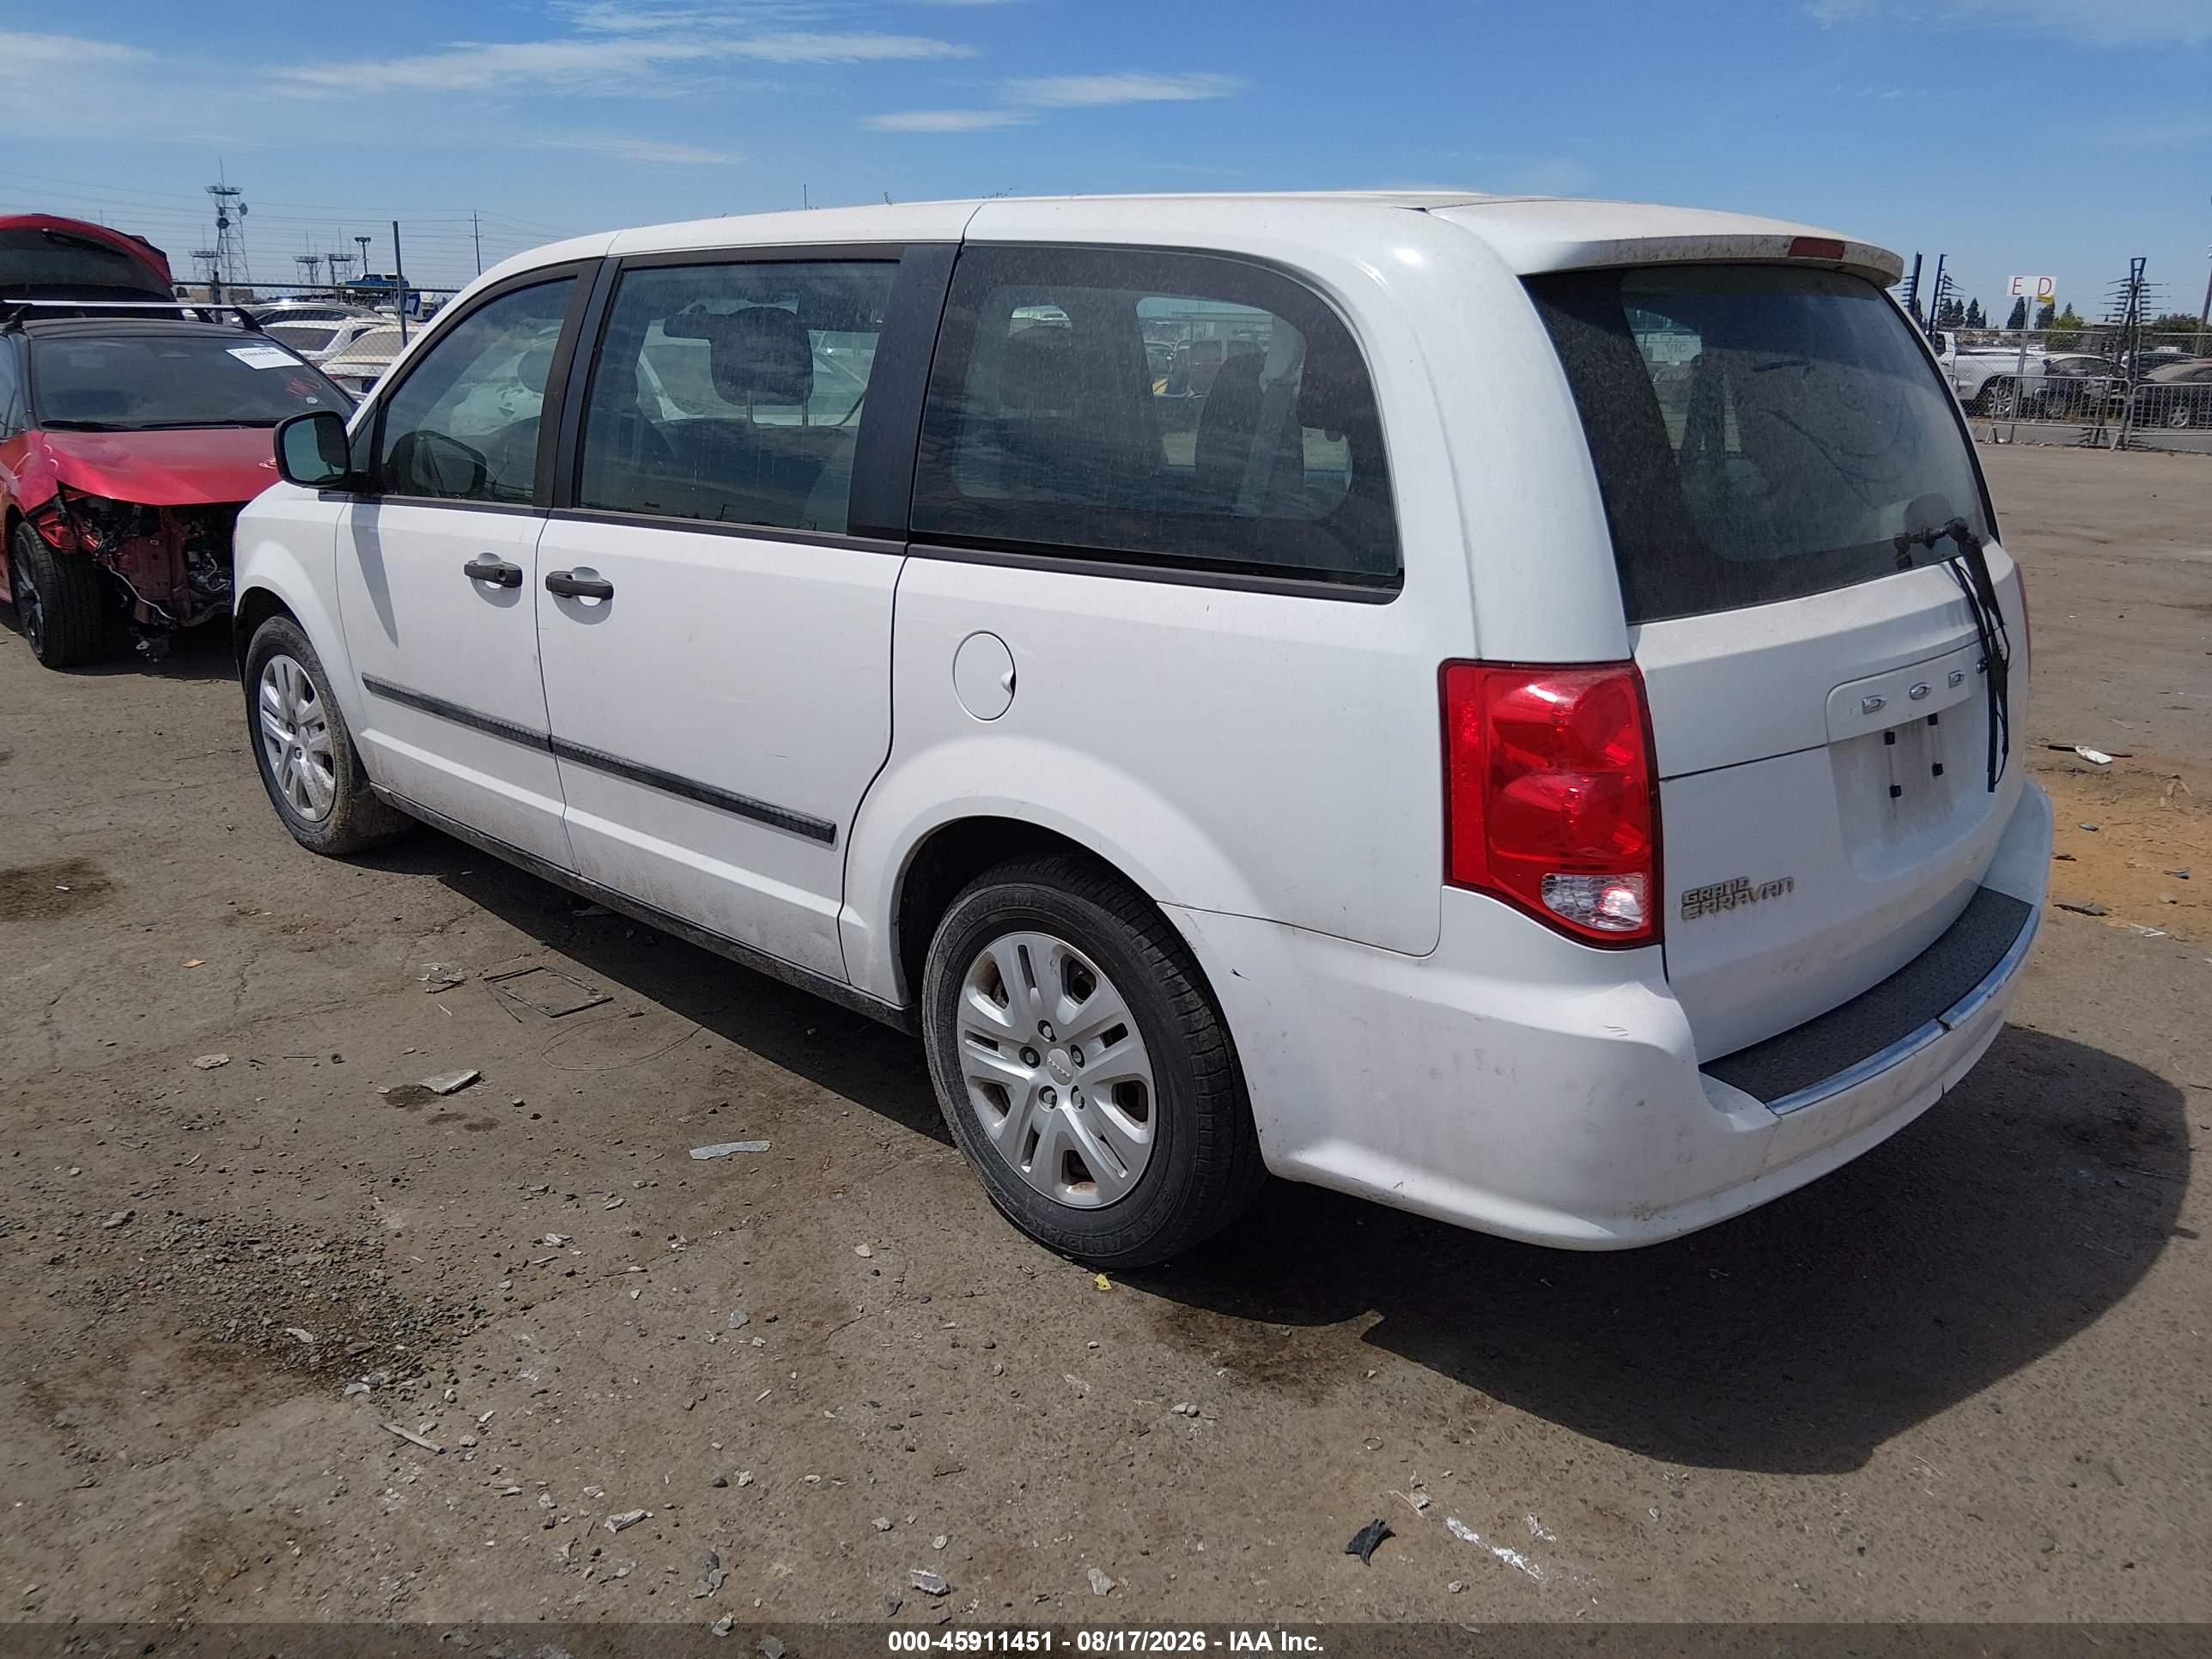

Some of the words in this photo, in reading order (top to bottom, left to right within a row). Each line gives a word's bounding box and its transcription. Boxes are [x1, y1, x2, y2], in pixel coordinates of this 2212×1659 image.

[2012, 276, 2023, 295] E
[2038, 276, 2051, 295] D
[1862, 659, 1987, 714] DOD
[1681, 877, 1794, 921] CARAVAN
[1682, 877, 1750, 903] GRAND
